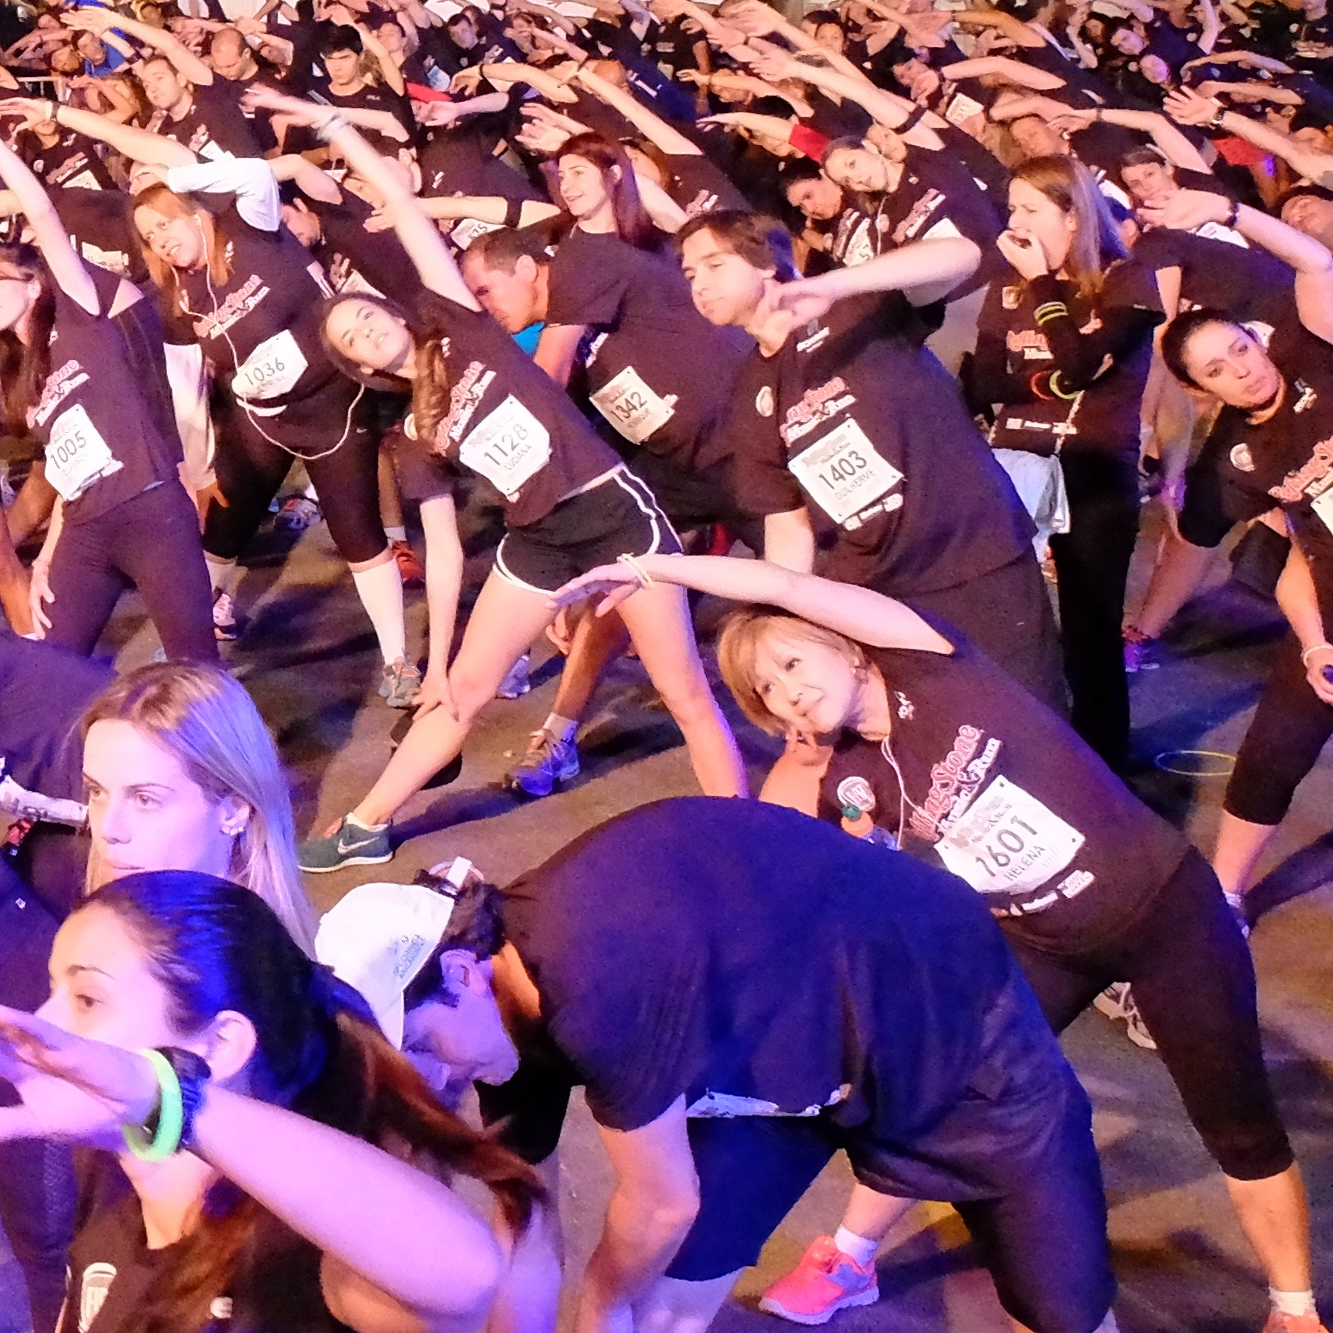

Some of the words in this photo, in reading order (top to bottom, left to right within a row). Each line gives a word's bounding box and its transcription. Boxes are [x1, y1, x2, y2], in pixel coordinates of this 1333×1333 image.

[244, 357, 286, 386] 1036
[610, 391, 648, 423] 1342
[50, 430, 87, 470] 1005
[483, 423, 529, 466] 1128
[818, 449, 867, 491] 1403
[975, 814, 1038, 878] 1601
[1003, 844, 1046, 882] HELENA
